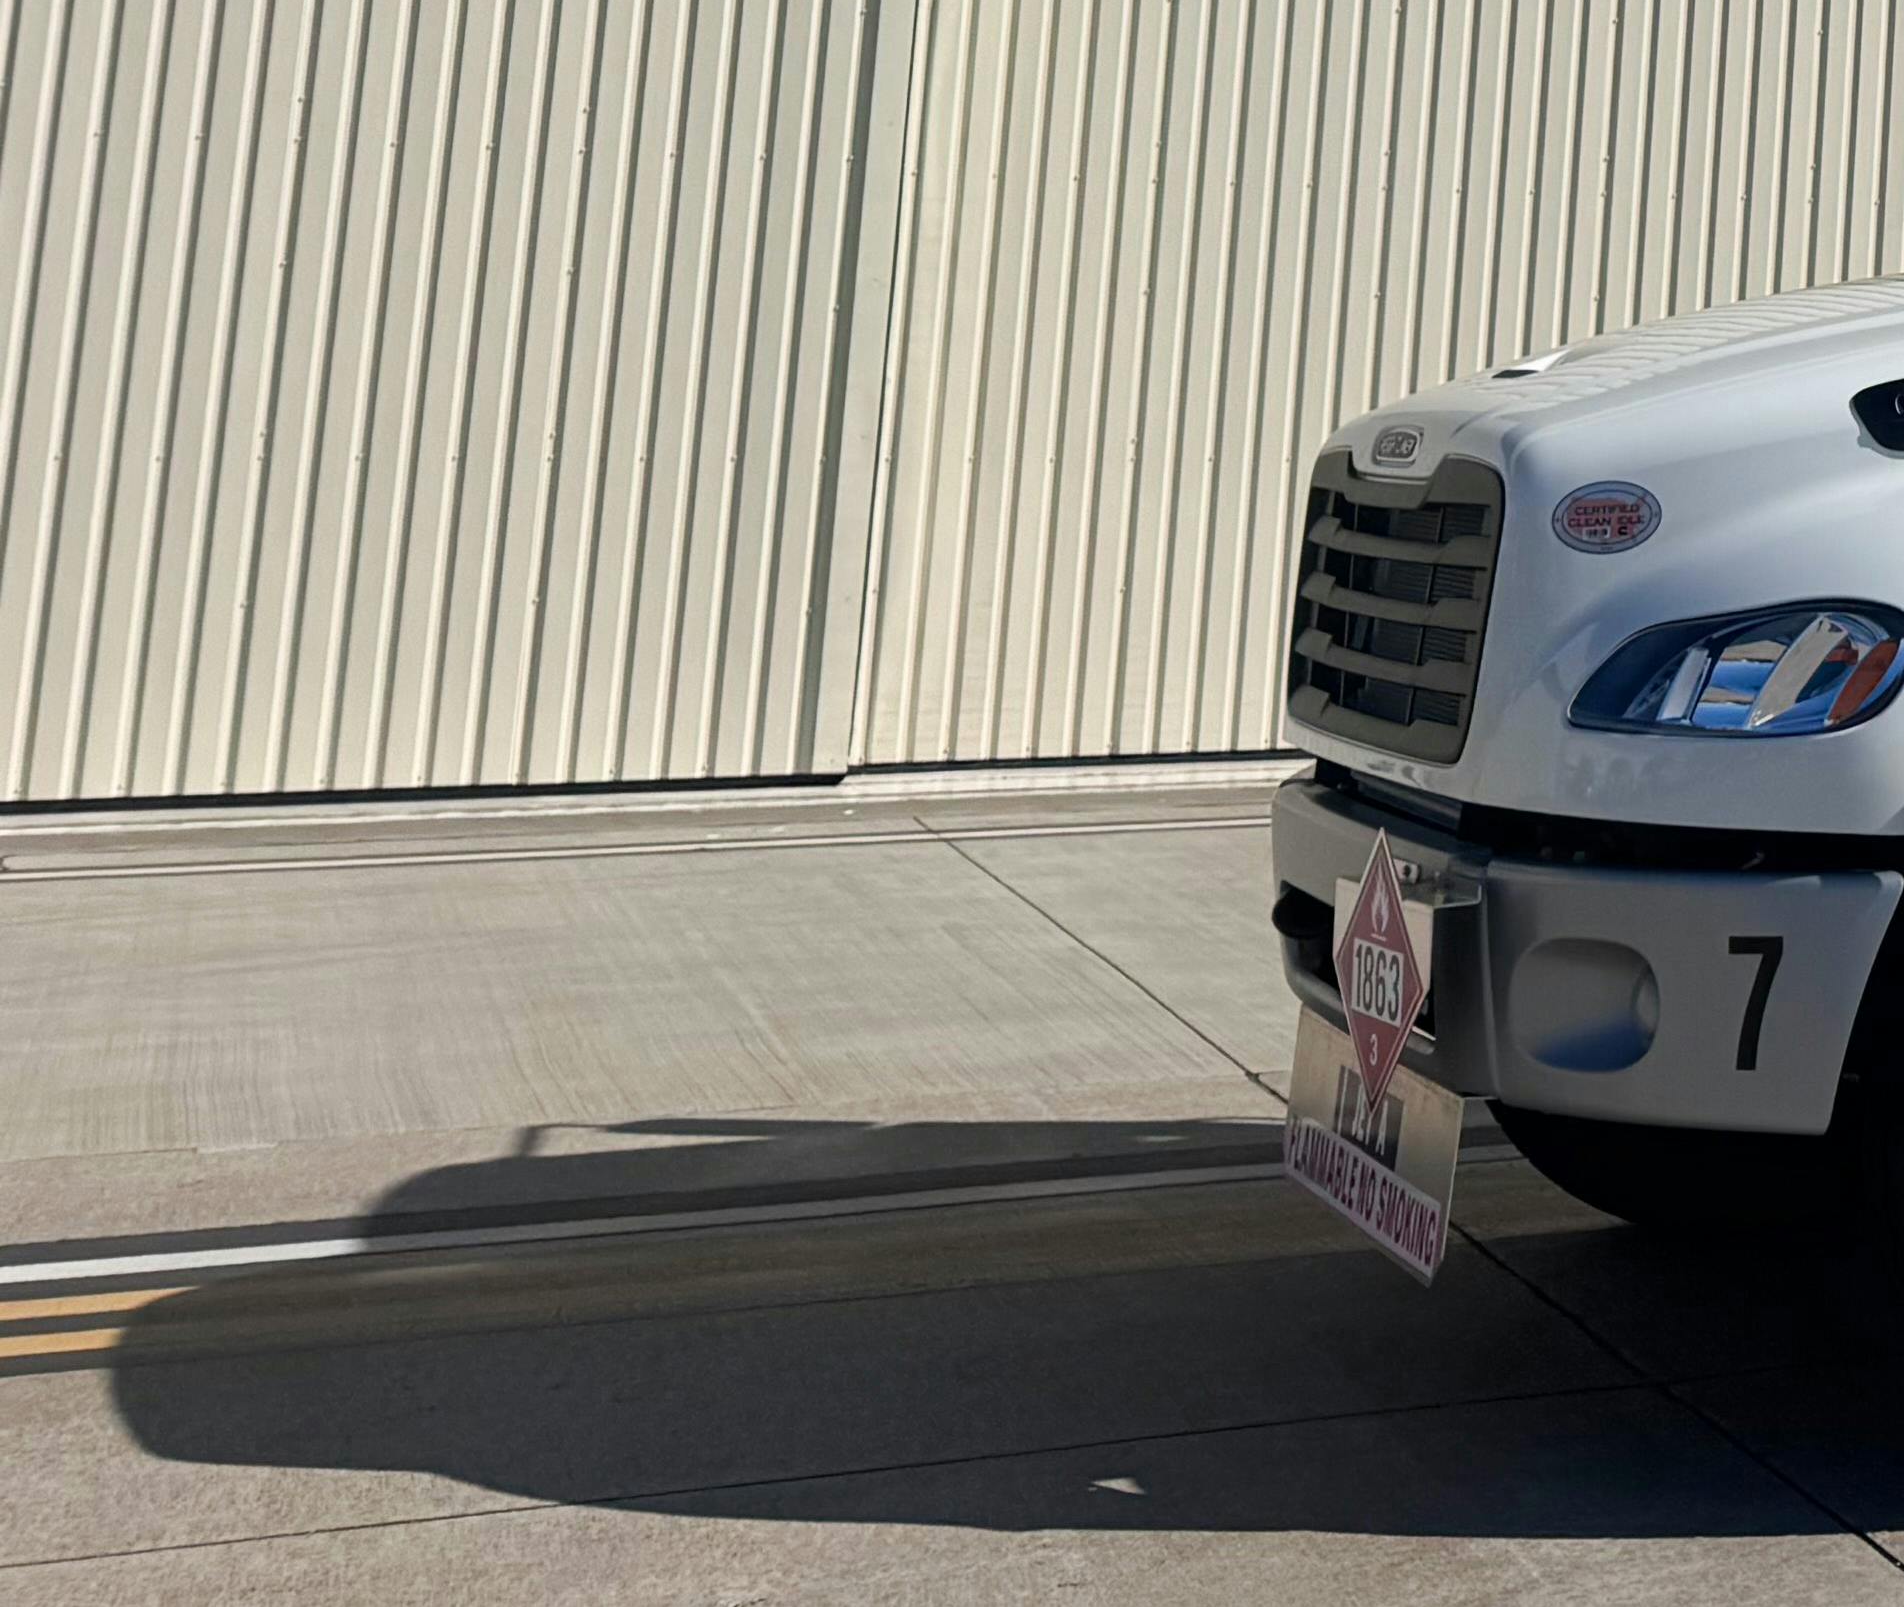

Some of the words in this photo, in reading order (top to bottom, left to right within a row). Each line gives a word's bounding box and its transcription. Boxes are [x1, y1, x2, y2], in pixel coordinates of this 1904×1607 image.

[1567, 517, 1611, 528] CLEAN
[1354, 943, 1401, 1022] 1863
[1728, 935, 1784, 1071] 7
[1370, 1033, 1378, 1067] 3
[1376, 1099, 1389, 1156] A
[1287, 1118, 1359, 1209] FLAMMABLE
[1358, 1161, 1377, 1222] NO
[1377, 1177, 1437, 1266] SMOKING
